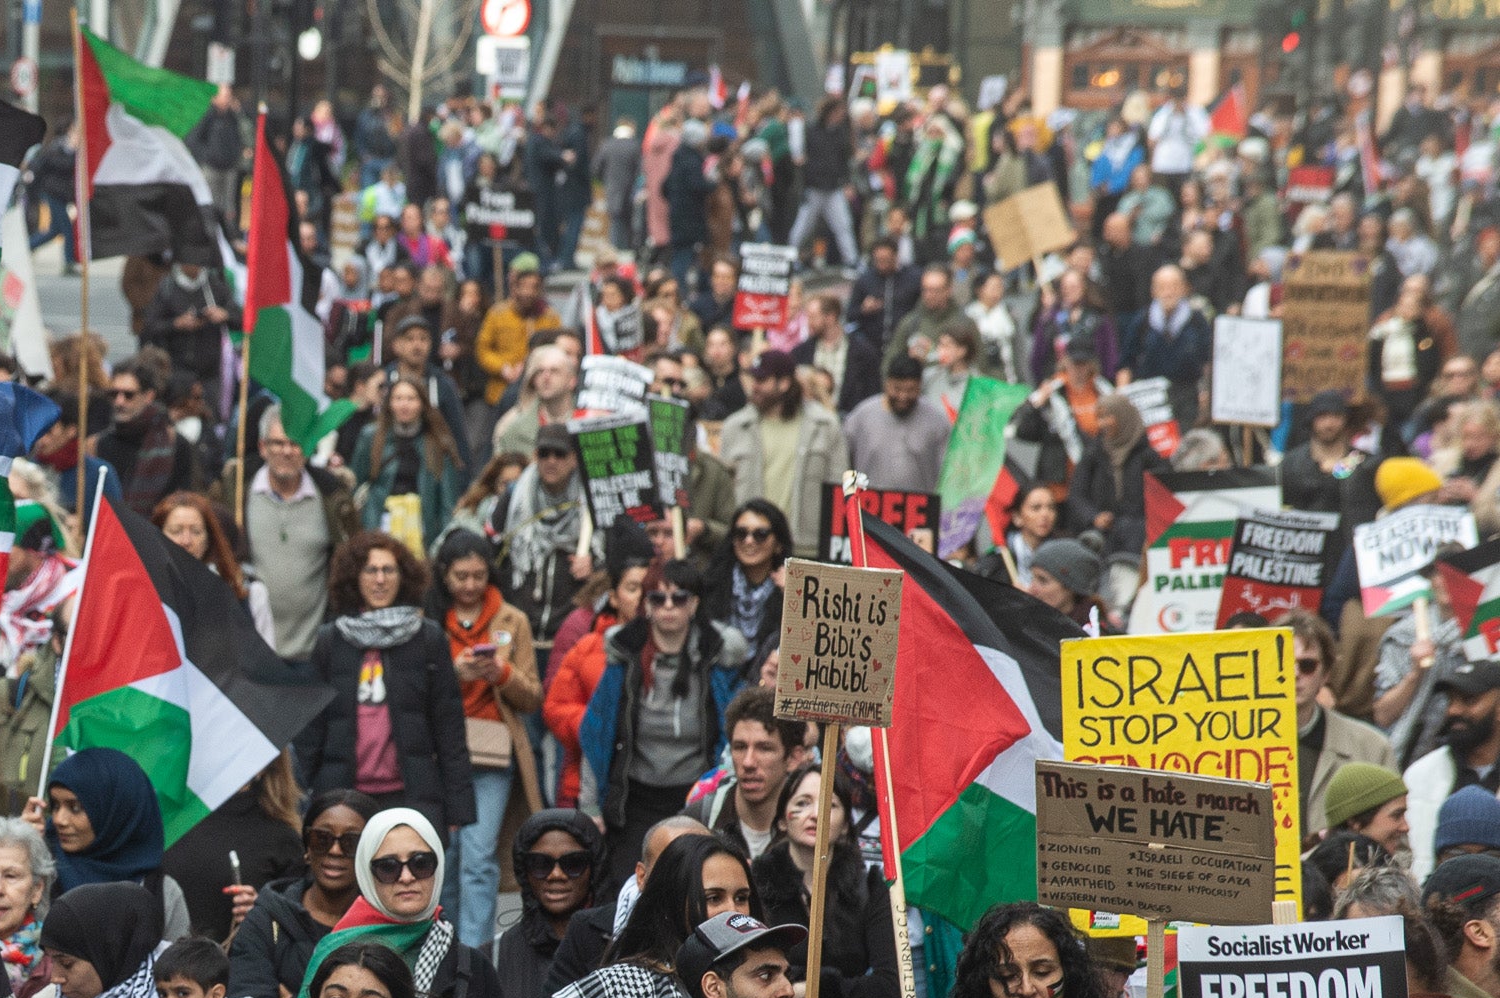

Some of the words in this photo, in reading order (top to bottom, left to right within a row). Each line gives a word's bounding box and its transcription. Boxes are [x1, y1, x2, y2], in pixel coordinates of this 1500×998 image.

[1168, 537, 1233, 569] FR
[1240, 522, 1327, 555] FREEDOM
[1154, 574, 1224, 592] PALES
[1230, 551, 1325, 586] PALESTINE
[802, 575, 862, 624] Rishi
[868, 594, 888, 626] is
[814, 622, 873, 662] Bibi's
[805, 657, 869, 693] Habibi
[1076, 634, 1288, 710] ISRAEL!
[1079, 713, 1178, 747] STOP
[1184, 707, 1282, 742] YOUR
[1072, 746, 1293, 788] CIDE
[1037, 770, 1088, 800] This
[1097, 779, 1117, 800] is
[1119, 785, 1136, 803] a
[1142, 777, 1187, 806] hate
[1195, 788, 1261, 816] march
[1085, 802, 1138, 834] WE
[1051, 860, 1112, 876] GENOCIDE
[1135, 866, 1154, 878] THE
[1160, 869, 1195, 881] SIEGE
[1197, 872, 1212, 882] OF
[1217, 874, 1251, 887] GAZA
[1137, 850, 1183, 865] ISRAELI
[1191, 856, 1263, 873] OCCUPATION
[1049, 892, 1098, 903] WESTERN
[1050, 876, 1116, 891] APARTHEID
[1135, 880, 1183, 892] WESTERN
[1187, 884, 1240, 899] HYPOCRISY
